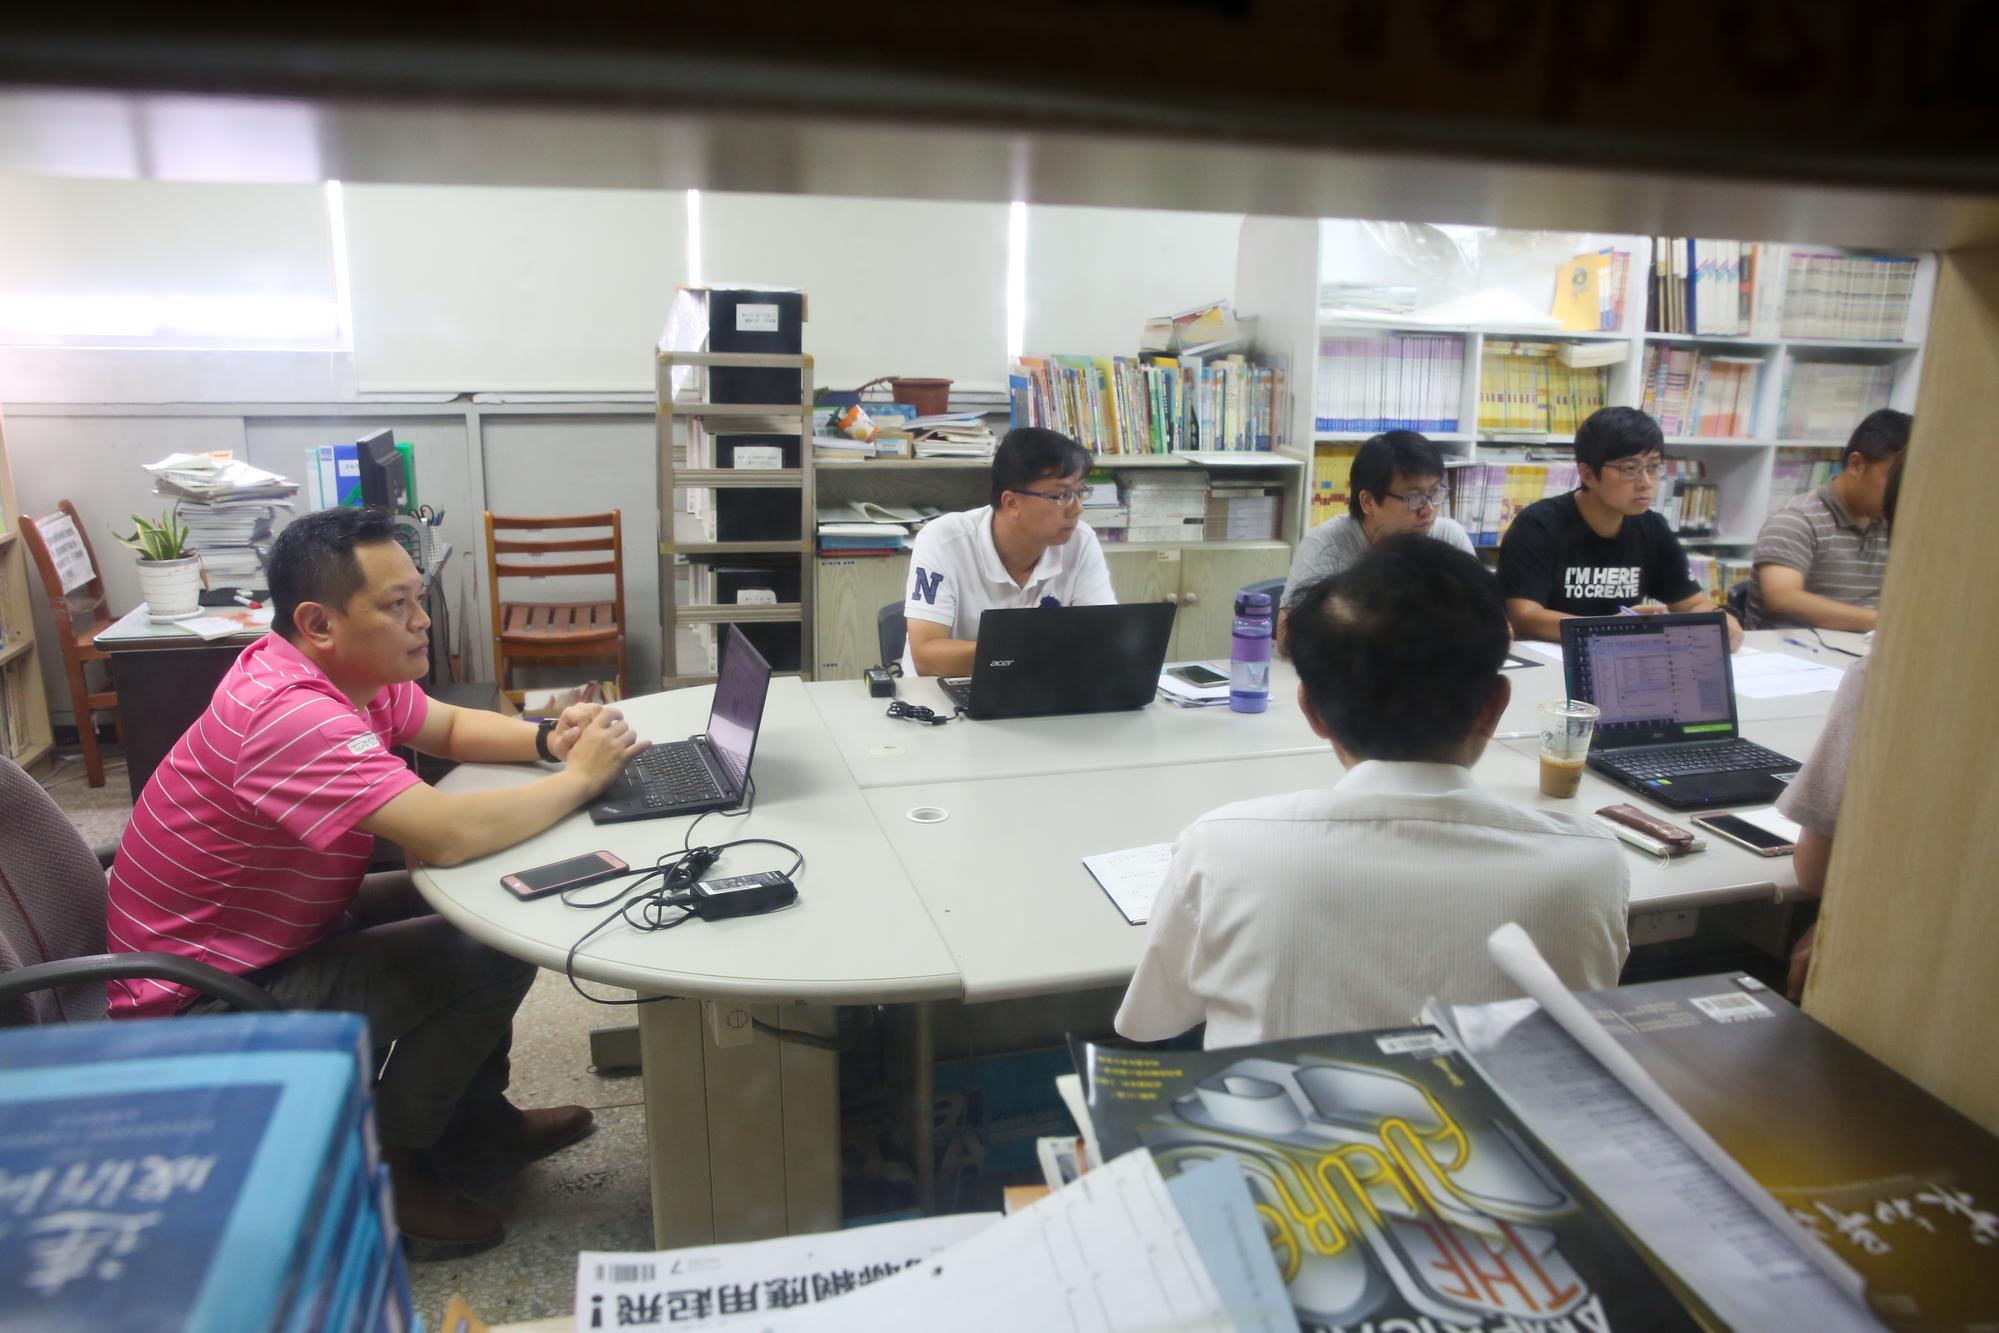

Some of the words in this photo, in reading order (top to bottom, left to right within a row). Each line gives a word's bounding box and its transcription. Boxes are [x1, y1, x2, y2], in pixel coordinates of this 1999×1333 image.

[1565, 567, 1591, 585] I'M
[1593, 567, 1641, 585] HERE
[912, 566, 944, 605] N
[1564, 584, 1583, 599] TO
[1584, 584, 1639, 599] CREATE
[990, 659, 1015, 667] acer
[1388, 1195, 1581, 1312] THE
